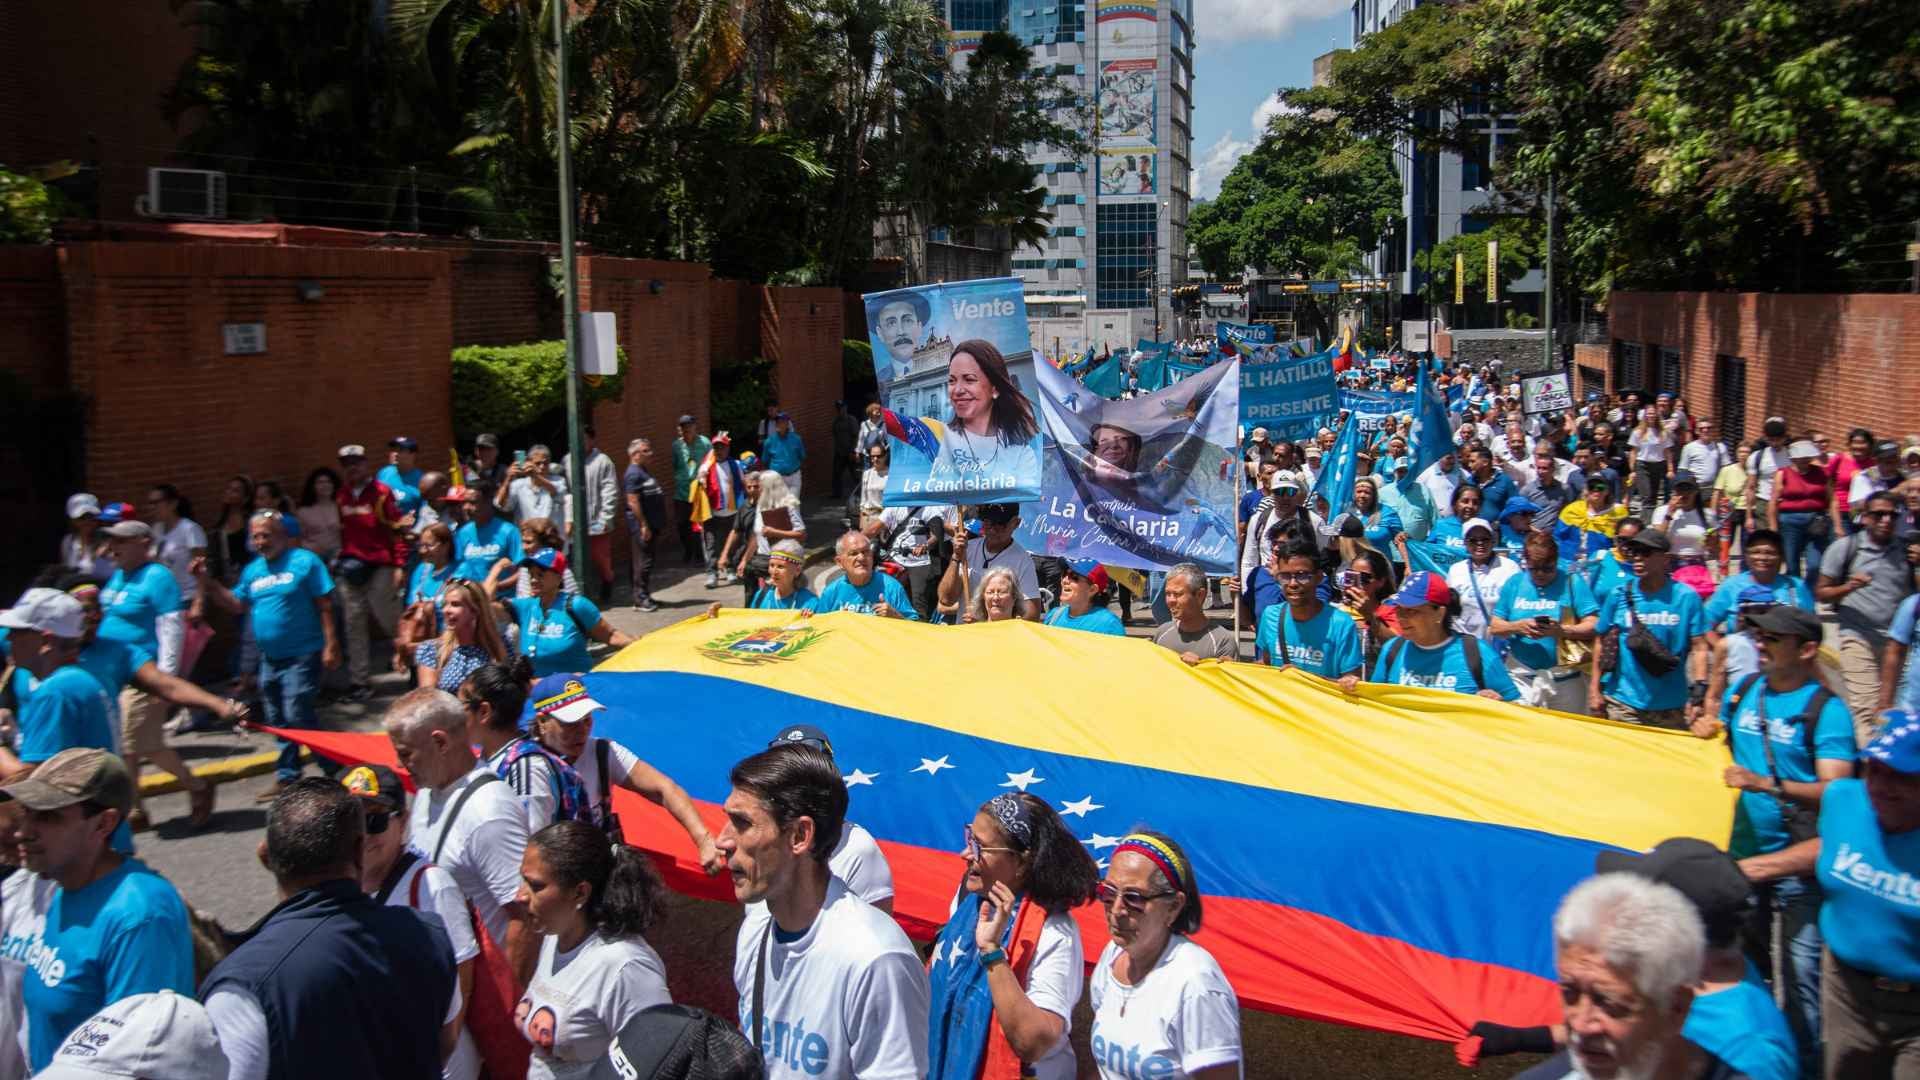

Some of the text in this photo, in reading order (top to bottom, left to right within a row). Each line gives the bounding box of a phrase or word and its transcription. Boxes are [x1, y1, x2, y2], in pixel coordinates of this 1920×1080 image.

[952, 298, 1016, 320] Vente
[1247, 395, 1333, 418] PRESENTE
[903, 473, 1018, 493] La Candelaria
[1050, 496, 1076, 519] La
[840, 600, 875, 614] Vent
[1512, 597, 1559, 611] Vente
[1398, 669, 1457, 688] Vente
[1092, 1030, 1176, 1080] ente
